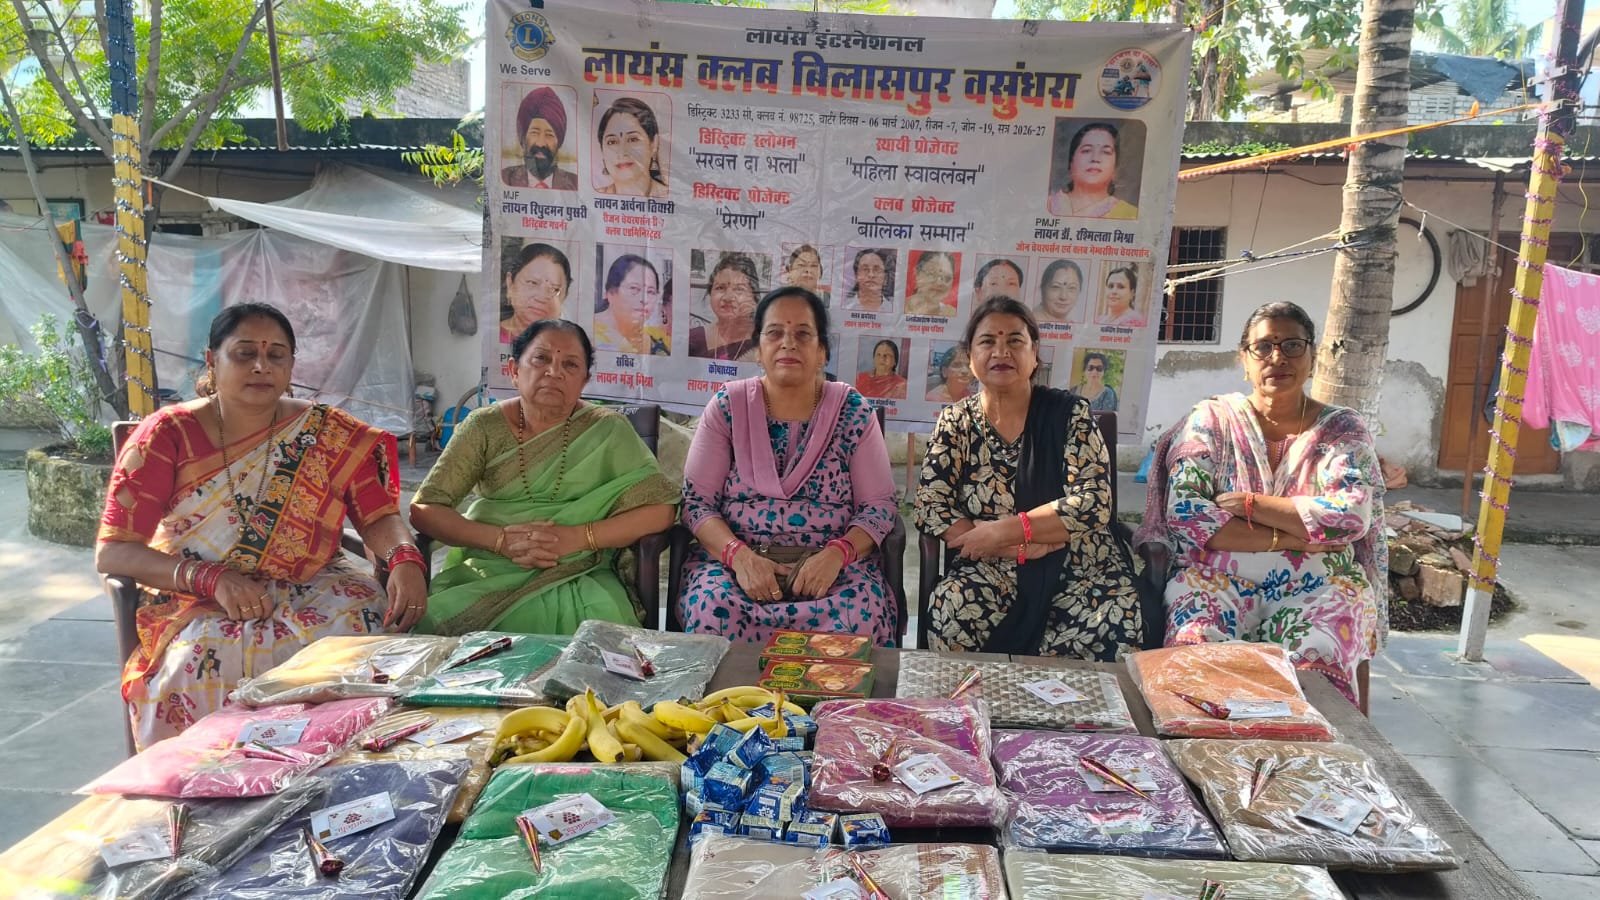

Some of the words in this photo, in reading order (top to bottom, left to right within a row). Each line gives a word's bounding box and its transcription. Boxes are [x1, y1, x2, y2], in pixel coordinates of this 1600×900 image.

[523, 27, 536, 44] L
[745, 26, 808, 46] लायंस
[815, 28, 926, 52] इंटरनेशनल
[500, 63, 522, 76] We
[524, 65, 551, 77] Serve
[581, 41, 688, 89] लायंस
[697, 53, 783, 95] क्लब
[791, 51, 956, 116] बिलासपुर
[964, 61, 1082, 120] वसुंधरा
[687, 103, 717, 123] डिस्ट्रिक्ट
[720, 108, 740, 117] 3233
[756, 110, 776, 121] क्लब
[839, 112, 859, 126] दिवस
[868, 118, 879, 127] 06
[882, 115, 898, 128] मार्च
[900, 118, 922, 131] 2007,
[925, 117, 944, 131] रीजन
[961, 118, 976, 132] जोन
[699, 127, 747, 149] डिस्ट्रिक्ट
[754, 131, 798, 149] स्लोगन
[914, 136, 960, 155] प्रोजेक्ट
[743, 154, 760, 172] दा
[766, 153, 805, 174] भला"
[845, 156, 899, 183] "महिला
[904, 161, 985, 185] स्वावलंबन"
[503, 191, 520, 200] MJF
[693, 182, 742, 202] डिस्ट्रिक्ट
[748, 185, 792, 205] प्रोजेक्ट
[502, 201, 527, 214] लायन
[530, 201, 563, 220] रिपुदमन
[594, 198, 618, 210] लायन
[620, 197, 645, 213] अर्चना
[647, 198, 675, 214] तिवारी
[874, 197, 904, 212] क्लब
[911, 195, 955, 214] प्रोजेक्ट
[716, 206, 765, 230] "प्रेरणा"
[1035, 217, 1061, 227] PMJF
[851, 215, 913, 240] "बालिका
[919, 222, 974, 243] सम्मान"
[1034, 228, 1059, 240] लायन
[1076, 228, 1112, 243] रश्मिलता
[1113, 230, 1135, 244] मिश्रा
[596, 371, 618, 385] लायन
[687, 379, 709, 393] लायन
